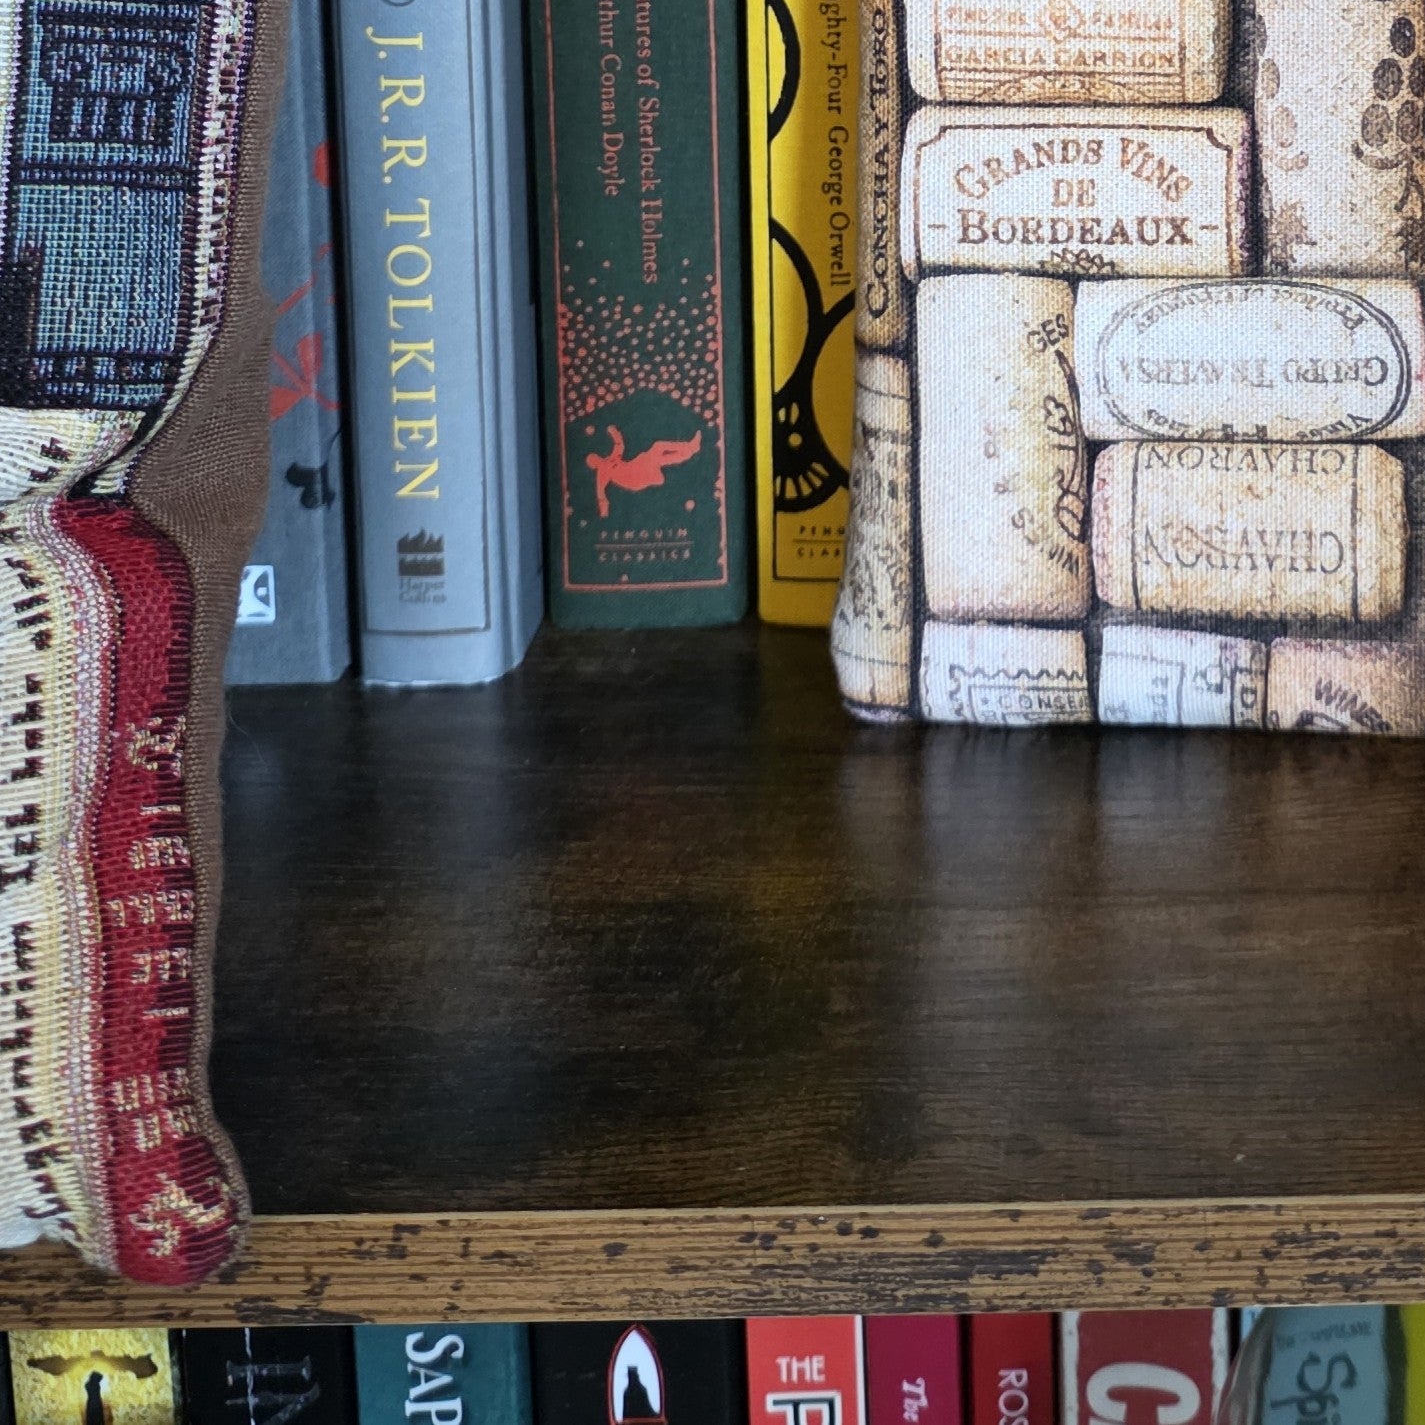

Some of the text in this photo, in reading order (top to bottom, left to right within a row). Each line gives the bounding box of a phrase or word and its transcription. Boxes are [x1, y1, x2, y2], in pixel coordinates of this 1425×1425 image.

[600, 53, 623, 126] Conan
[637, 63, 660, 91] of
[597, 131, 626, 197] Doyle
[637, 96, 663, 193] Sherlock
[821, 131, 850, 205] George
[953, 135, 1195, 205] GRANDS VINS
[957, 207, 1195, 246] BORDEAUX
[1051, 178, 1097, 208] DE
[639, 197, 664, 285] Holmes
[826, 217, 852, 287] Orwell
[384, 197, 442, 501] TOLKIEN
[600, 527, 691, 542] PENGUIN
[776, 1355, 827, 1383] THE
